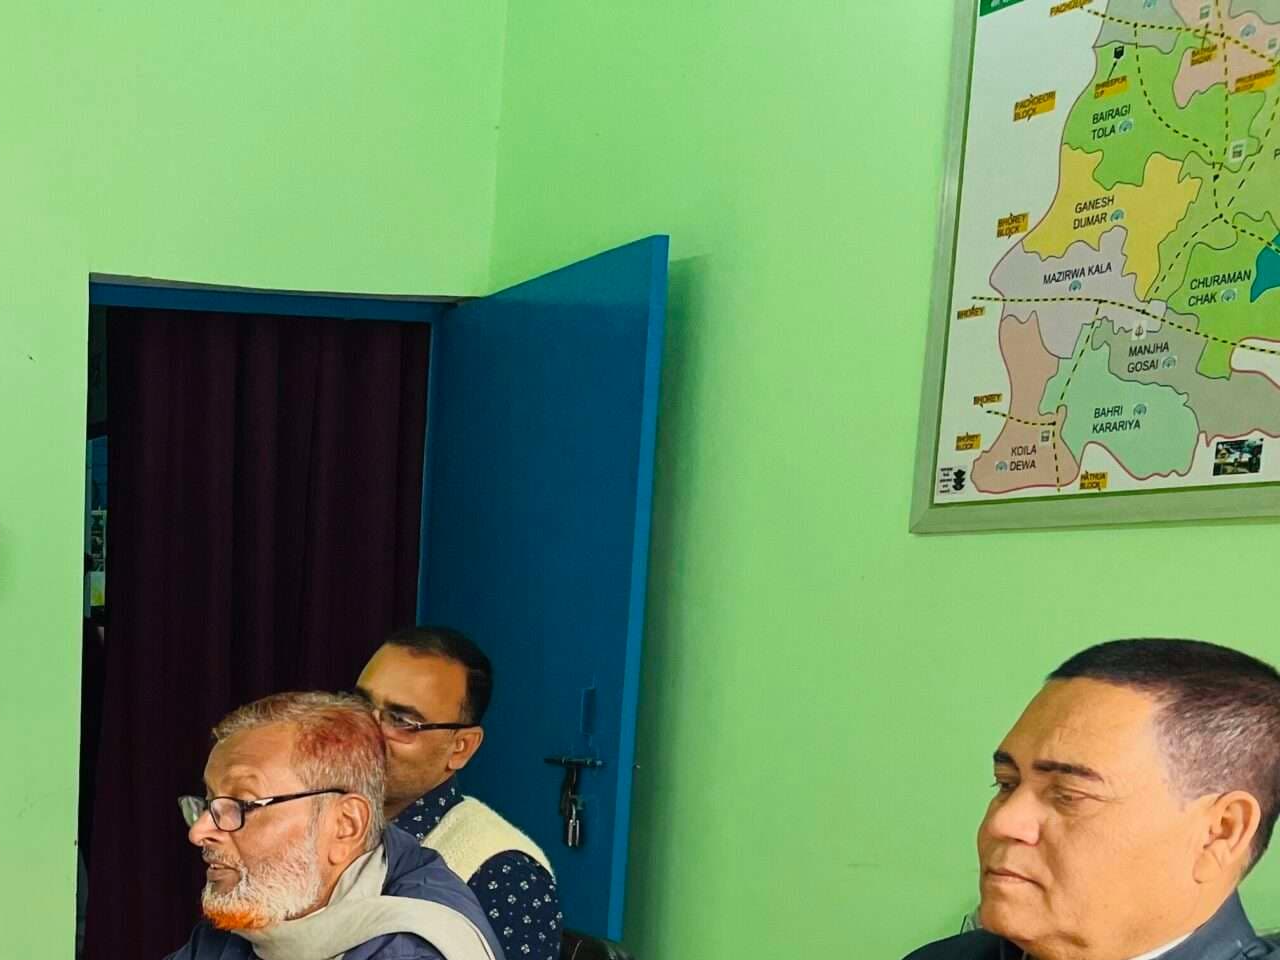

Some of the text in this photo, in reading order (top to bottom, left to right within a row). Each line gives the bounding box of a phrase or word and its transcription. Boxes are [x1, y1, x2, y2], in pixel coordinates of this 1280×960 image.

[1092, 104, 1131, 124] BAIRAGI
[1092, 125, 1116, 140] TOLA
[1075, 195, 1115, 214] GANESH
[1072, 213, 1108, 230] DUMAR
[1043, 261, 1112, 284] MAZIRWA KALA
[1190, 269, 1252, 290] CHURAMAN
[1188, 292, 1218, 307] CHAK
[1128, 341, 1170, 357] MANJHA
[1127, 359, 1159, 373] GOSAI
[1093, 404, 1124, 419] BAHRI
[1091, 419, 1141, 434] KARARIYA
[1010, 444, 1037, 456] KOILA
[1009, 460, 1036, 472] DEWA
